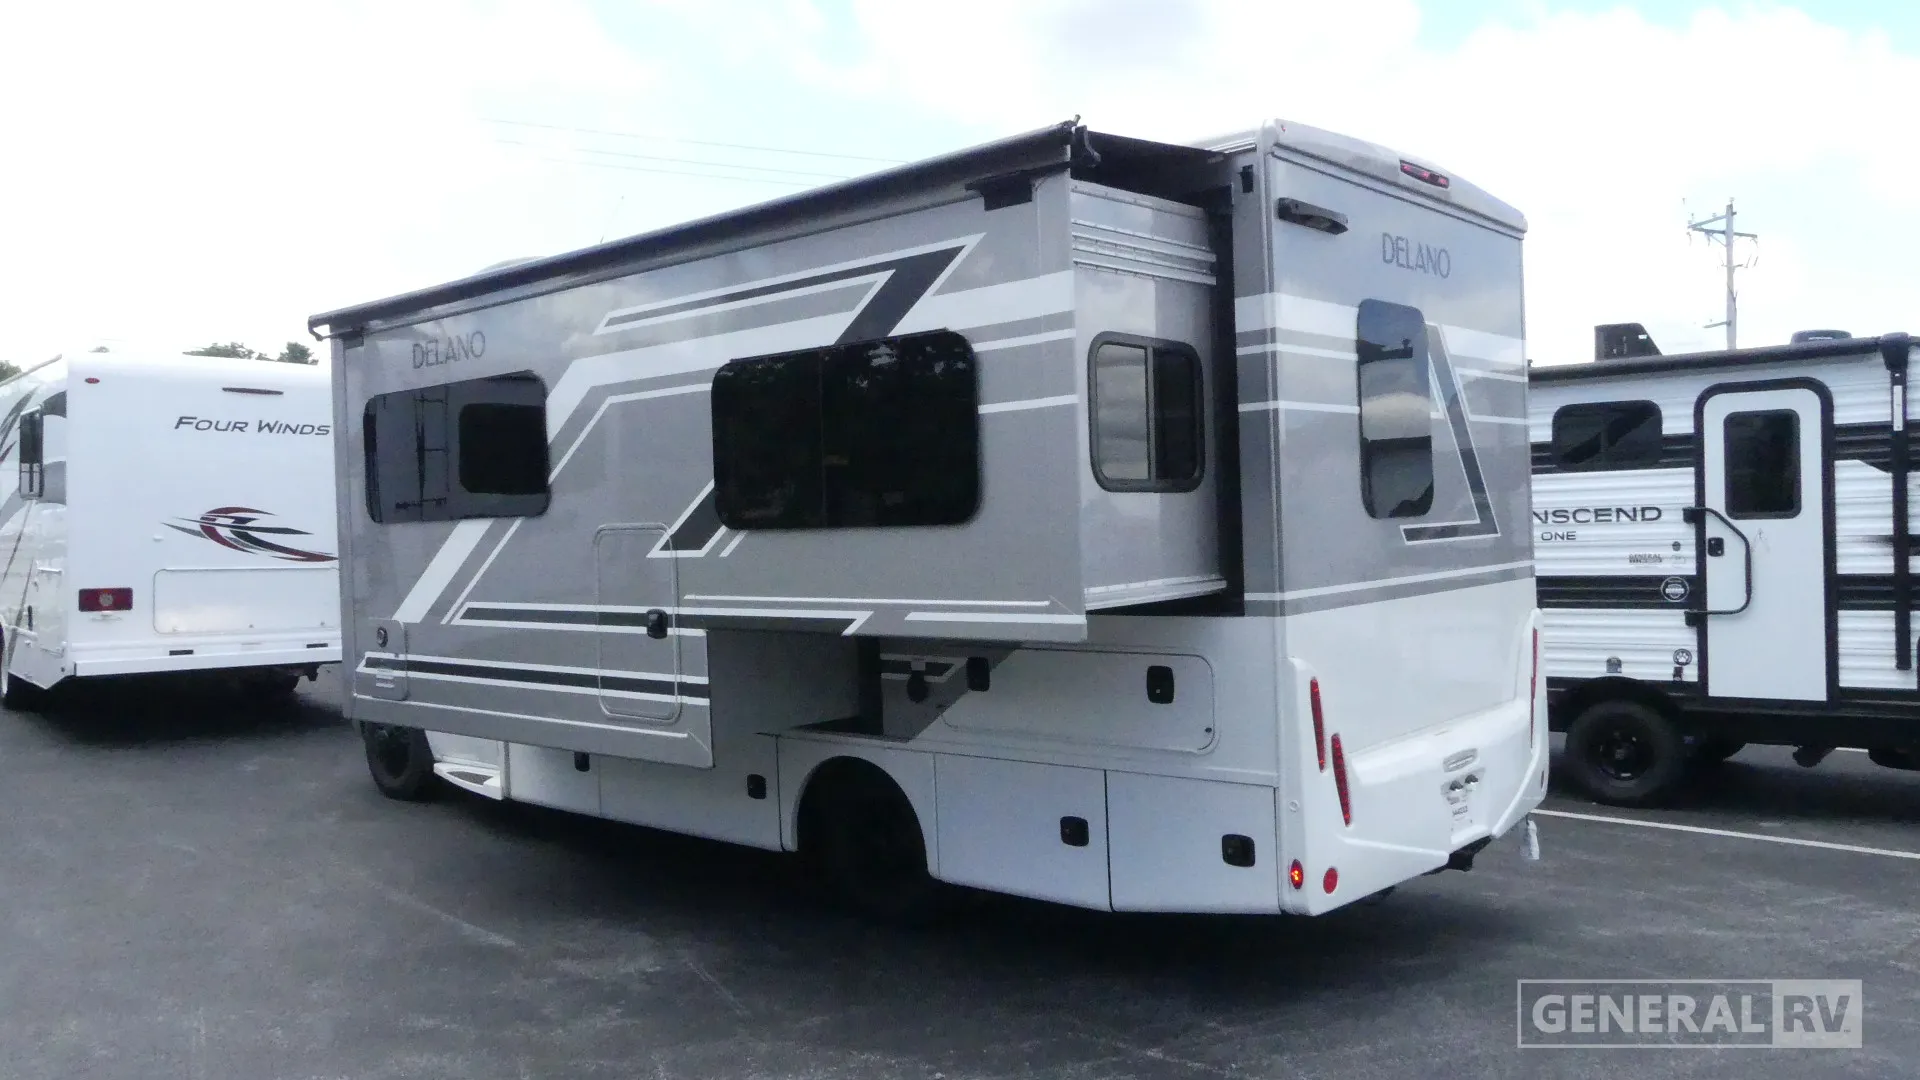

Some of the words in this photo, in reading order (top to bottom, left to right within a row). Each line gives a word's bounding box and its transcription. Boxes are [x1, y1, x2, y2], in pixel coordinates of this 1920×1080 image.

[1382, 231, 1451, 279] DELANO
[412, 330, 486, 369] DELANO
[174, 416, 249, 433] FOUR
[257, 419, 331, 436] WINDS
[1541, 531, 1577, 541] ONE
